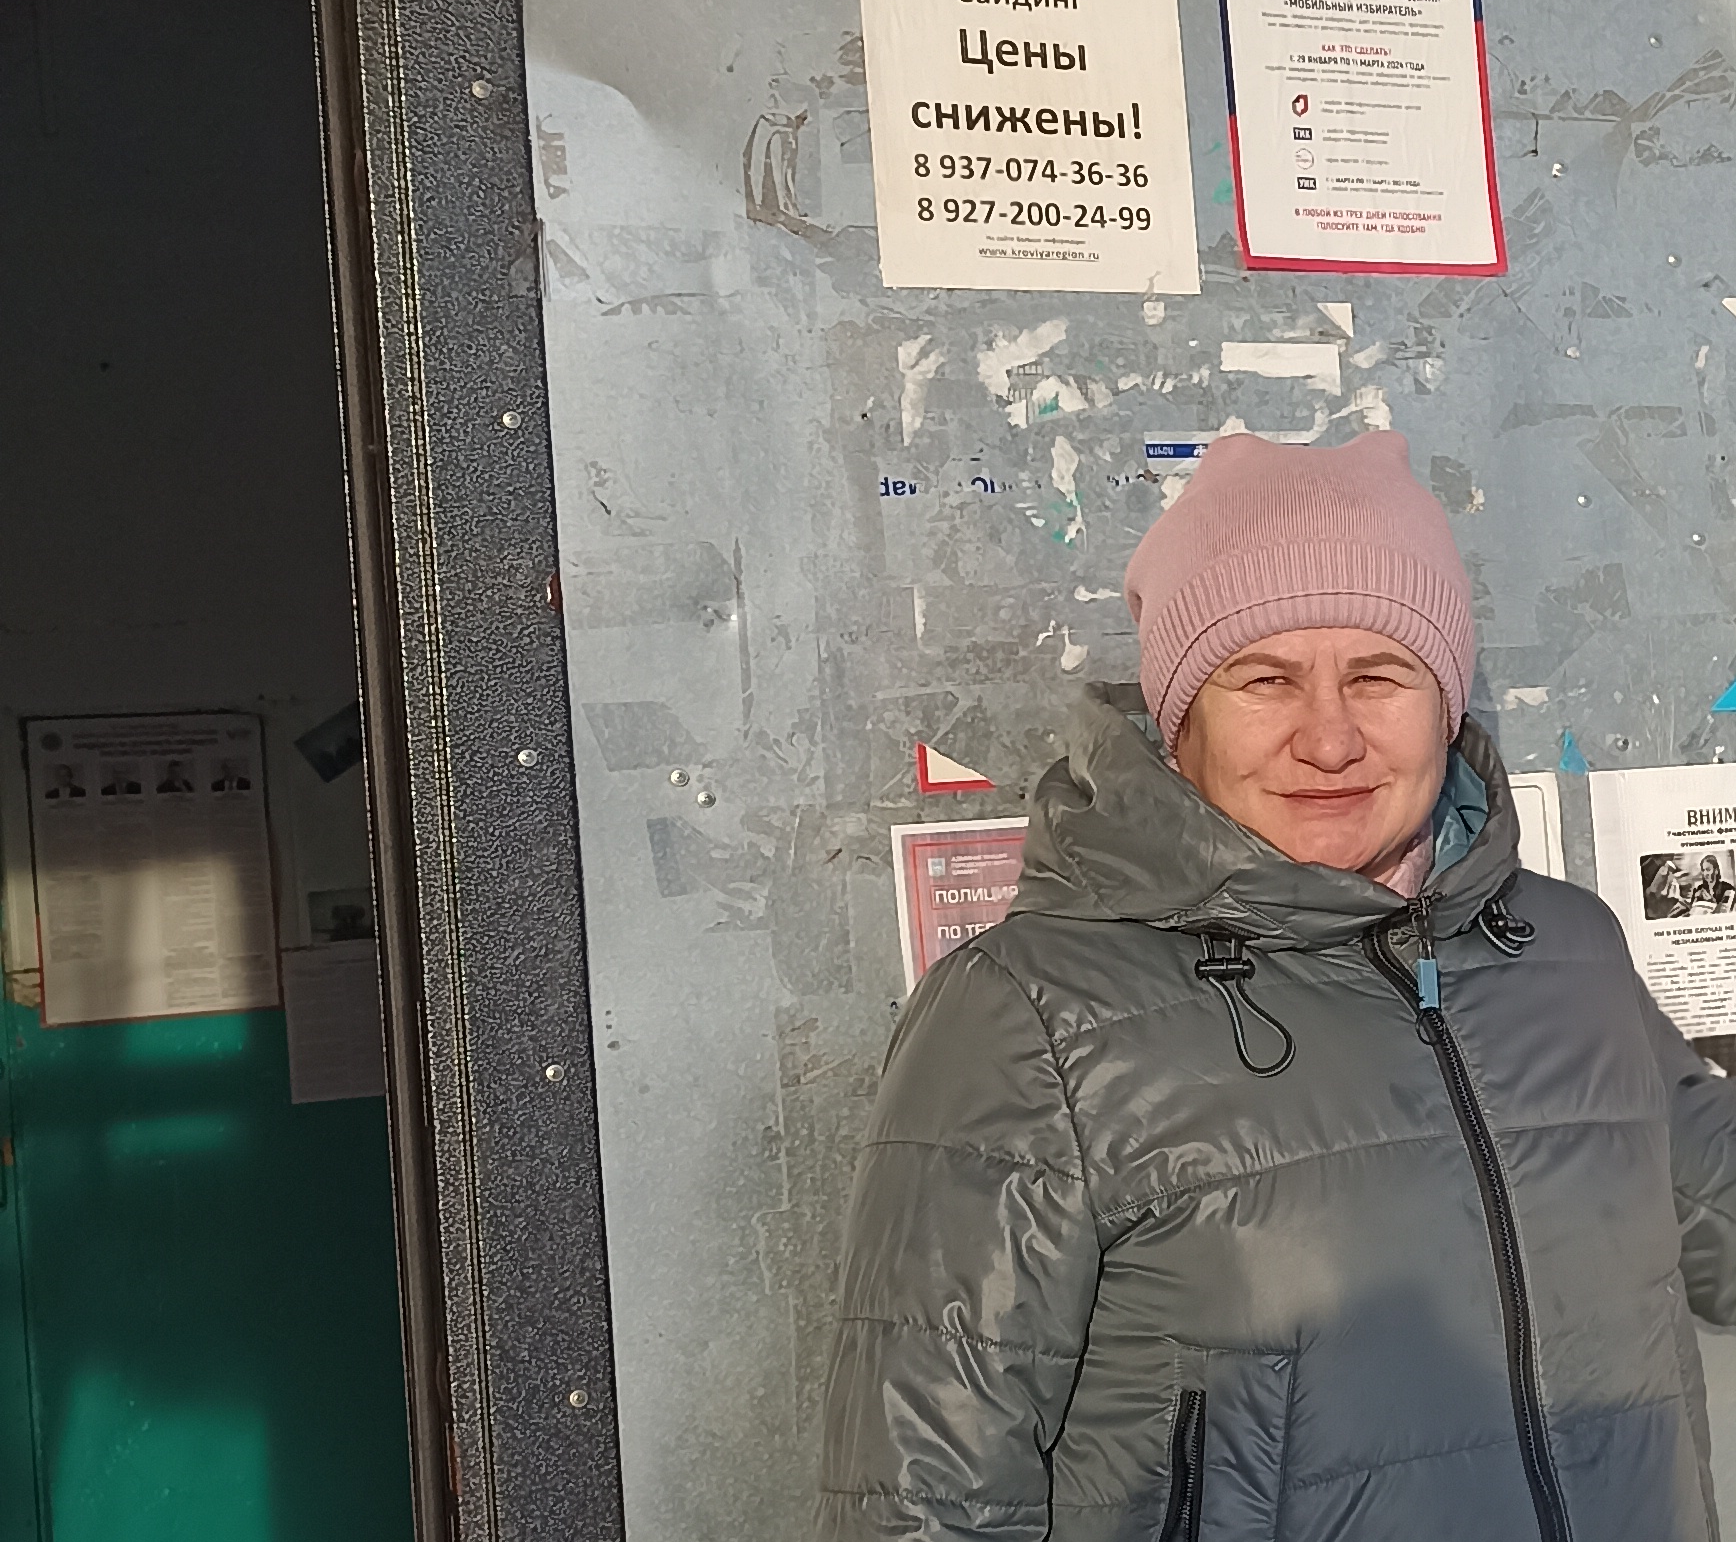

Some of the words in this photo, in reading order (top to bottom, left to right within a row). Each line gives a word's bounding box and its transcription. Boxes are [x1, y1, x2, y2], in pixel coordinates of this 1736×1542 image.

[959, 28, 1088, 75] Цены
[910, 99, 1142, 140] снижены!
[914, 153, 931, 178] 8
[939, 153, 1149, 189] 937-074-36-36
[917, 197, 934, 222] 8
[944, 198, 1152, 231] 927-200-24-99
[935, 885, 1018, 904] ПОЛИЦИЯ
[938, 925, 961, 940] ПО
